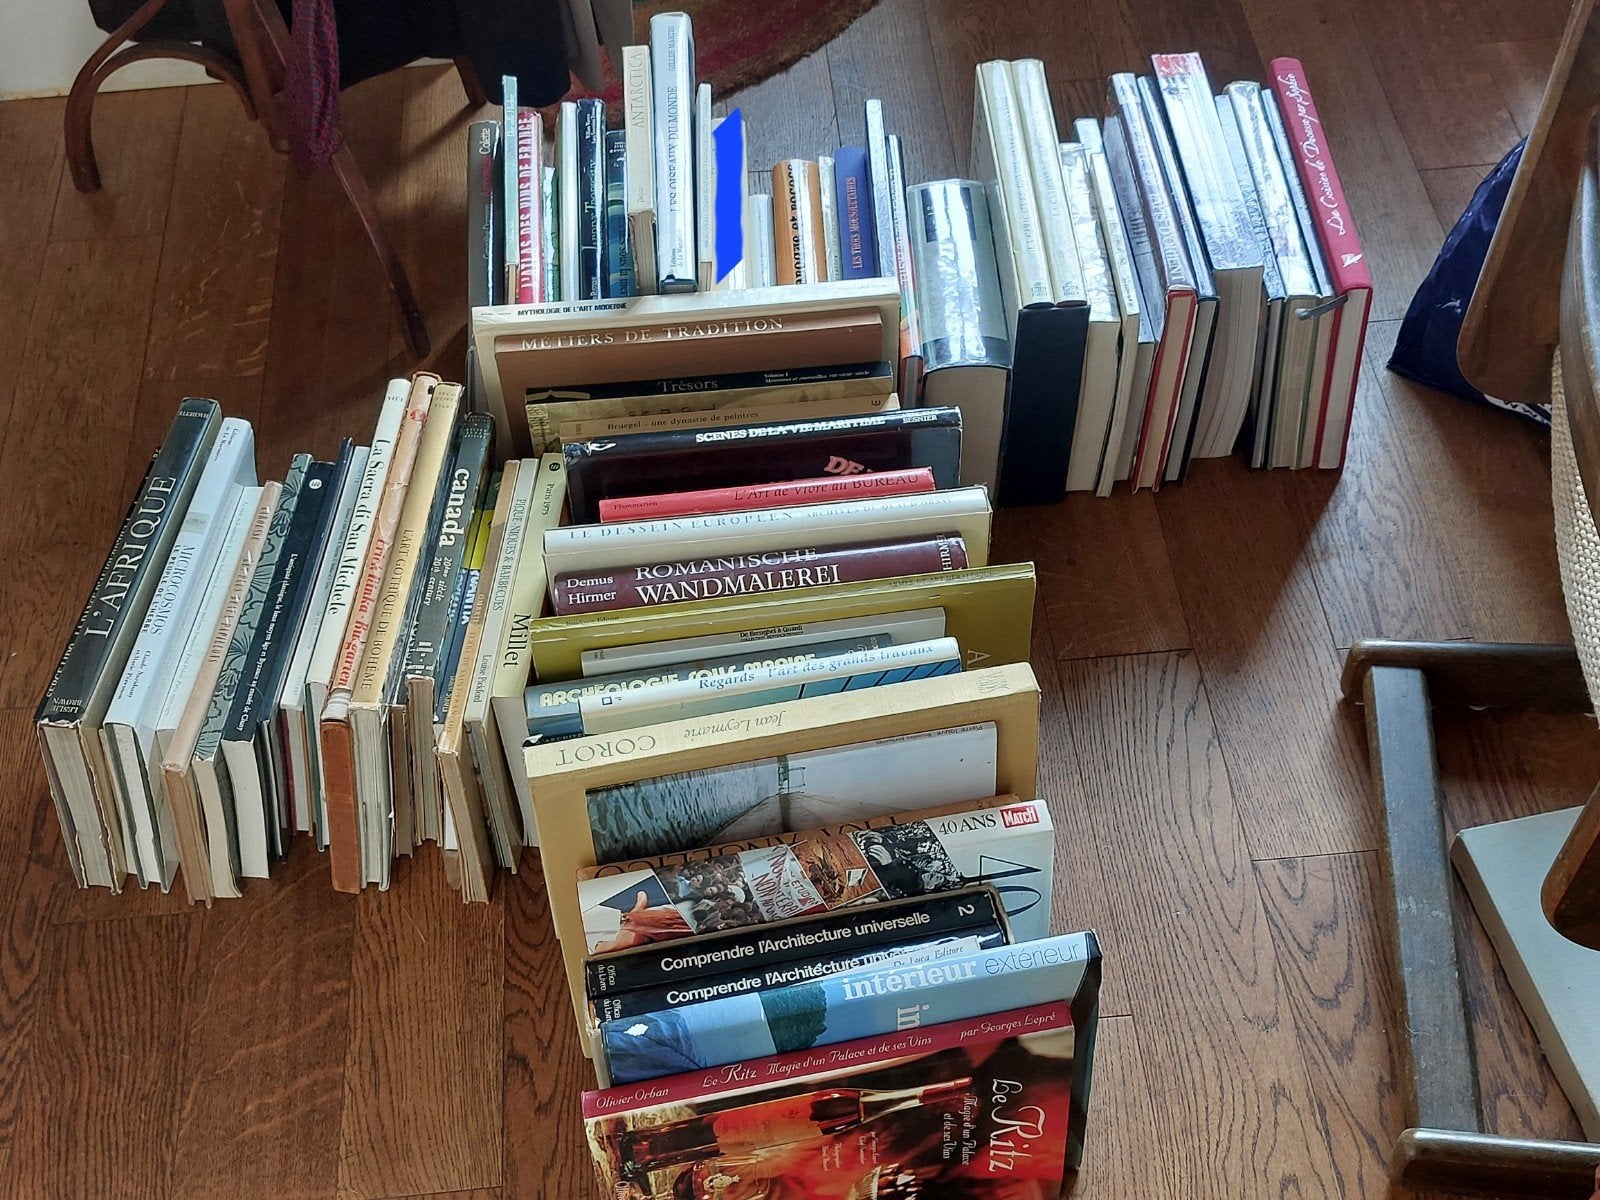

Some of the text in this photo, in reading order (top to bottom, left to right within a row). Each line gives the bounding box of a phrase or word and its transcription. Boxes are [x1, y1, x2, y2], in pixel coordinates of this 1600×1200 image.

[667, 25, 676, 71] GILLES MARTIN
[630, 52, 645, 128] ANTARCTICA
[1277, 73, 1309, 105] Sophie
[668, 86, 678, 123] MONDE
[479, 127, 491, 155] Colette
[518, 118, 531, 160] FRANCE
[668, 124, 678, 140] DU
[518, 164, 531, 177] DE
[1304, 159, 1325, 171] de
[519, 178, 532, 209] VINS
[668, 188, 679, 212] LES
[1319, 171, 1339, 208] Cuisine
[519, 213, 532, 235] DES
[846, 176, 862, 268] LES TROIS MOUSQUETAIRES
[1327, 210, 1346, 235] La
[518, 307, 561, 316] MYTHOLOGIE
[594, 303, 627, 311] MODERNE
[625, 329, 652, 342] DE
[662, 318, 783, 339] TRADITION
[657, 379, 719, 393] Trésors
[607, 420, 641, 430] Bruegel
[670, 414, 707, 425] dynastie
[711, 413, 721, 421] de
[724, 411, 759, 422] peintres
[695, 415, 886, 443] SCENES DE LA VIE MARITIME
[902, 414, 938, 424] BESNIER
[372, 438, 390, 456] La
[360, 460, 385, 501] Sacra
[733, 485, 770, 501] L'Art
[775, 485, 788, 497] de
[832, 480, 848, 491] au
[852, 473, 918, 489] BUREAU
[355, 504, 371, 520] di
[439, 468, 470, 548] canada
[541, 483, 555, 516] Paris 1975
[806, 507, 859, 518] ARCHIVES
[346, 522, 368, 546] San
[570, 530, 592, 539] LE
[601, 521, 682, 537] DESSEIN
[83, 476, 177, 639] L'AFRIQUE
[492, 499, 527, 612] PIQUE-NIQUES BARBECUES
[635, 547, 819, 581] ROMANISCHE
[142, 544, 181, 634] LE PEUPLE DE L'HERBE
[151, 545, 195, 635] MICROCOSMOS
[327, 556, 359, 615] Michele
[423, 556, 443, 606] 20th century
[435, 579, 447, 602] siècle
[566, 575, 613, 589] Demus
[634, 564, 841, 605] WANDMALEREI
[360, 529, 414, 690] L'ART GOTHIQUE DE BOHÊME
[568, 590, 616, 606] Hirmer
[502, 613, 532, 668] Millet
[783, 624, 803, 633] Guardi
[140, 650, 151, 671] Claude
[699, 643, 934, 690] Regards l'art des grands travaux
[472, 653, 493, 703] Louise Pickford
[50, 705, 80, 714] LESLIE
[52, 697, 82, 707] BROWN
[684, 711, 786, 741] Jean Leymarie
[937, 725, 983, 736] Pierre Jouve
[556, 735, 656, 766] COROT
[939, 813, 997, 835] 40 ANS
[1002, 808, 1037, 827] MATCH
[957, 904, 976, 917] 2
[660, 912, 931, 972] Comprendre l'Architecture universelle
[934, 945, 963, 960] Editore
[599, 975, 607, 991] Livre
[607, 965, 616, 986] Office
[666, 957, 860, 1005] Comprendre l'Architecture
[842, 942, 1080, 1000] intérieur extérieur
[959, 1011, 1056, 1041] par Georges Lepré
[702, 1035, 932, 1088] Le Ritz Magie d'un Palace et de ses Vins
[597, 1087, 669, 1109] Olivier Orban
[957, 1095, 978, 1166] Magie d'un Palace
[988, 1078, 1046, 1173] Le Ritz
[942, 1140, 958, 1160] Vins
